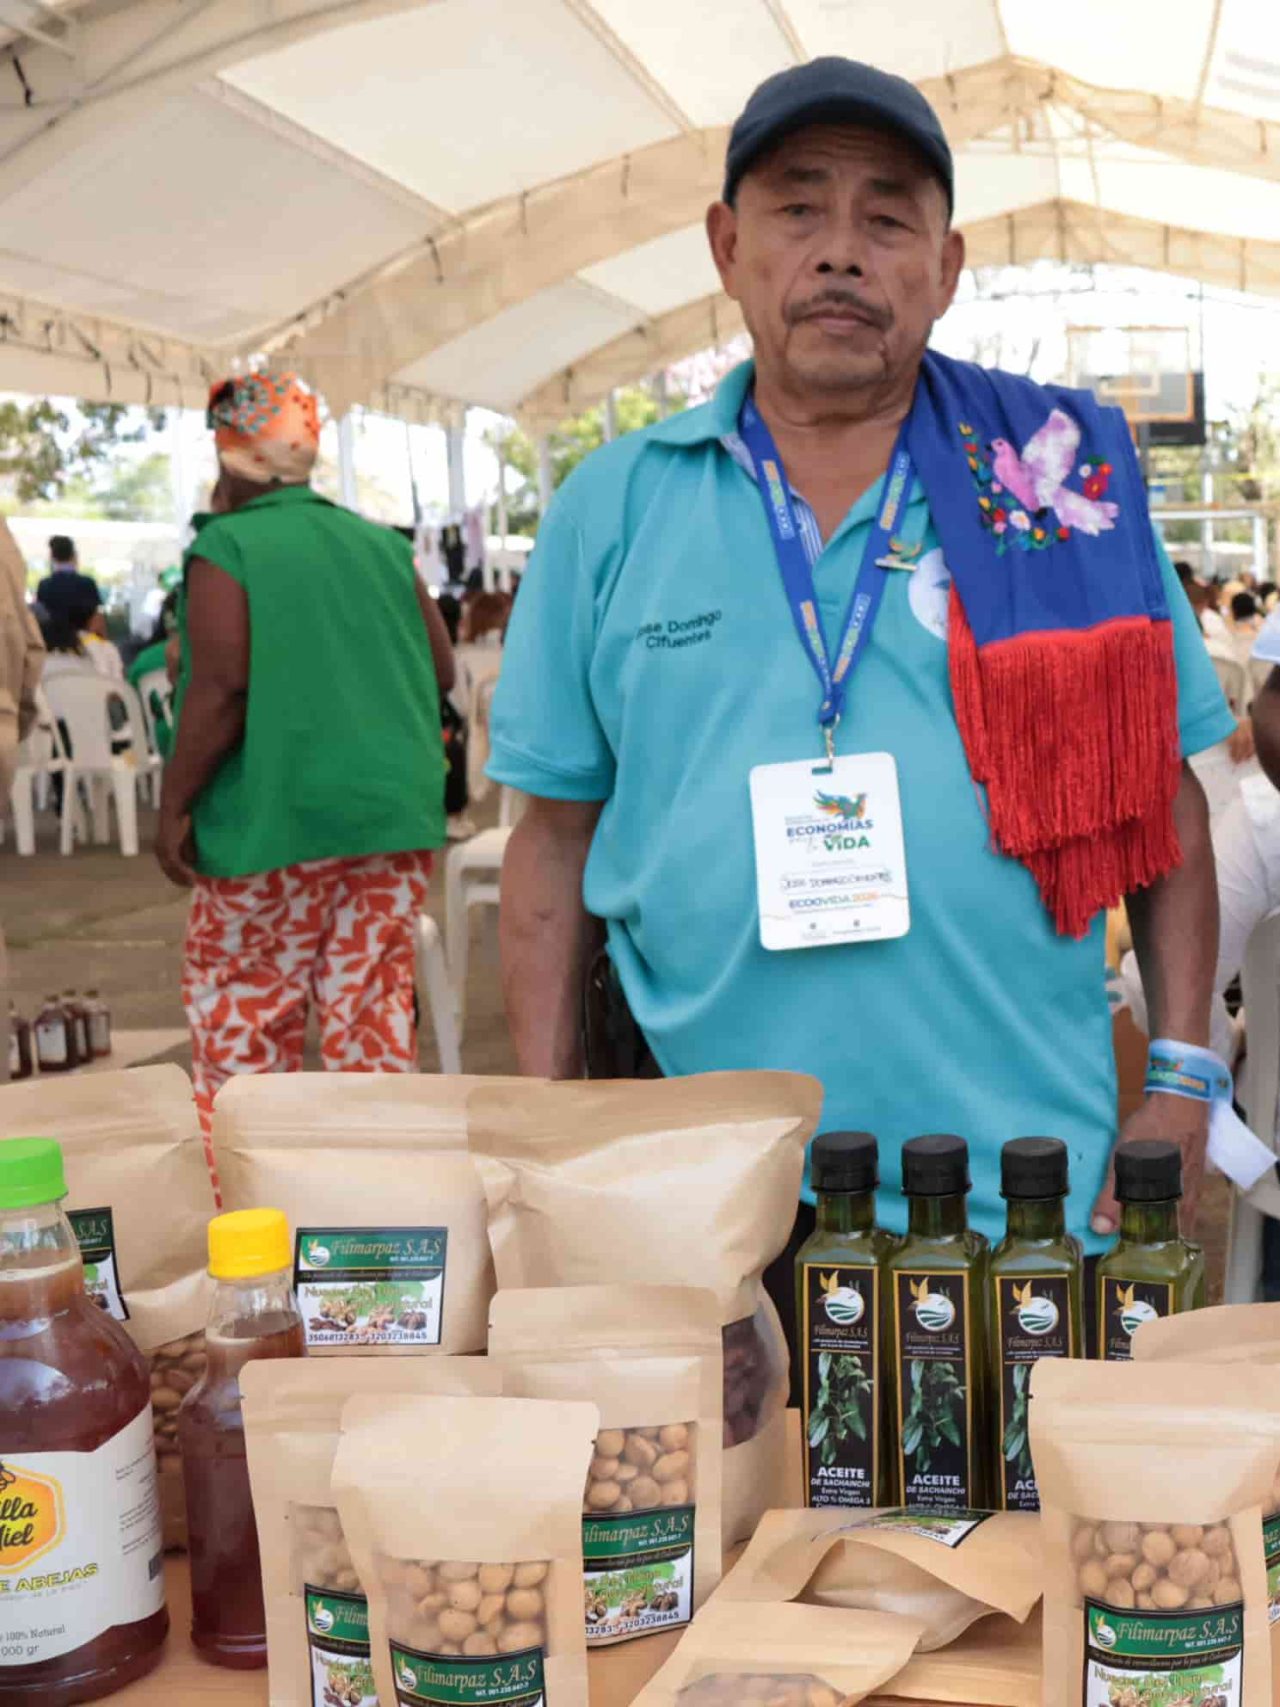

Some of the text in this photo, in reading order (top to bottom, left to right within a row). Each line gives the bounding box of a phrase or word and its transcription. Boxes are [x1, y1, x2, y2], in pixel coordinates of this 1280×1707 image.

[818, 1466, 865, 1478] ACEITE
[913, 1474, 960, 1486] ACEITE
[583, 1525, 649, 1546] ilimarpaz
[16, 1563, 97, 1592] ABEJAS
